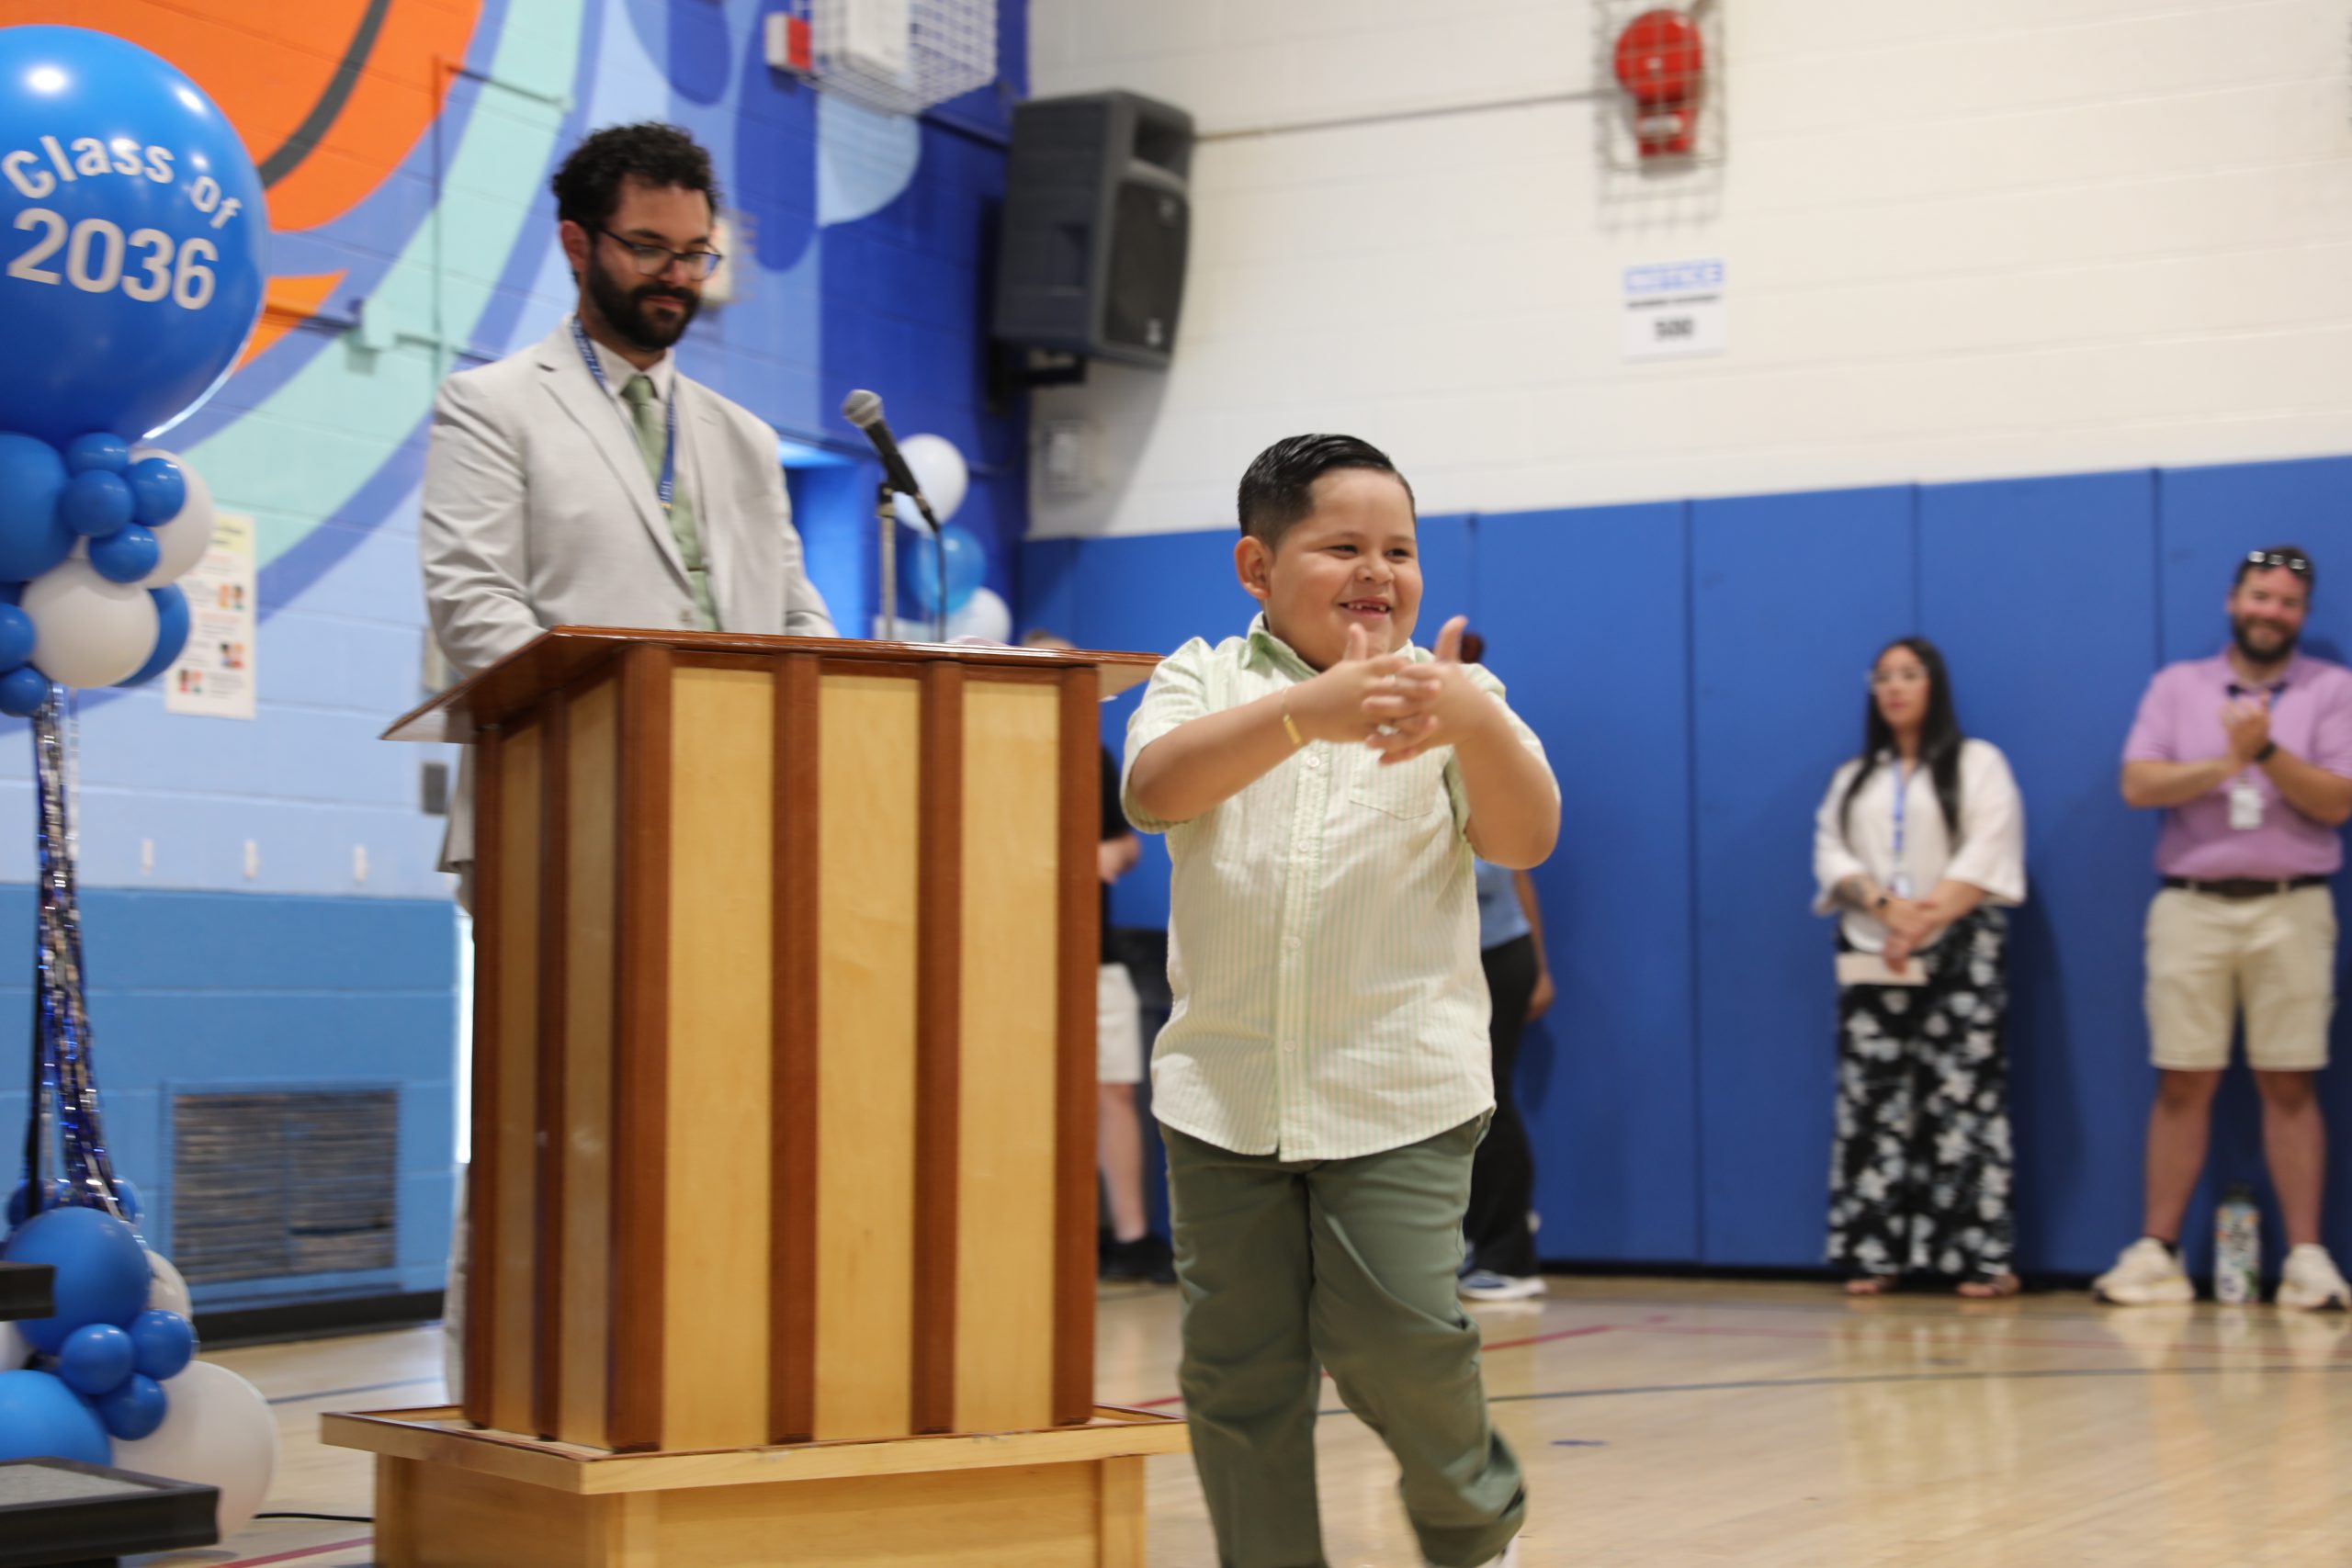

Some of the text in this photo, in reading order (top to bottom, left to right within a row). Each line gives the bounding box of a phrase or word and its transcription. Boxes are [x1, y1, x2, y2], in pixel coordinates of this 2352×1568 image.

[1, 135, 243, 229] Class of
[6, 208, 219, 310] 2036
